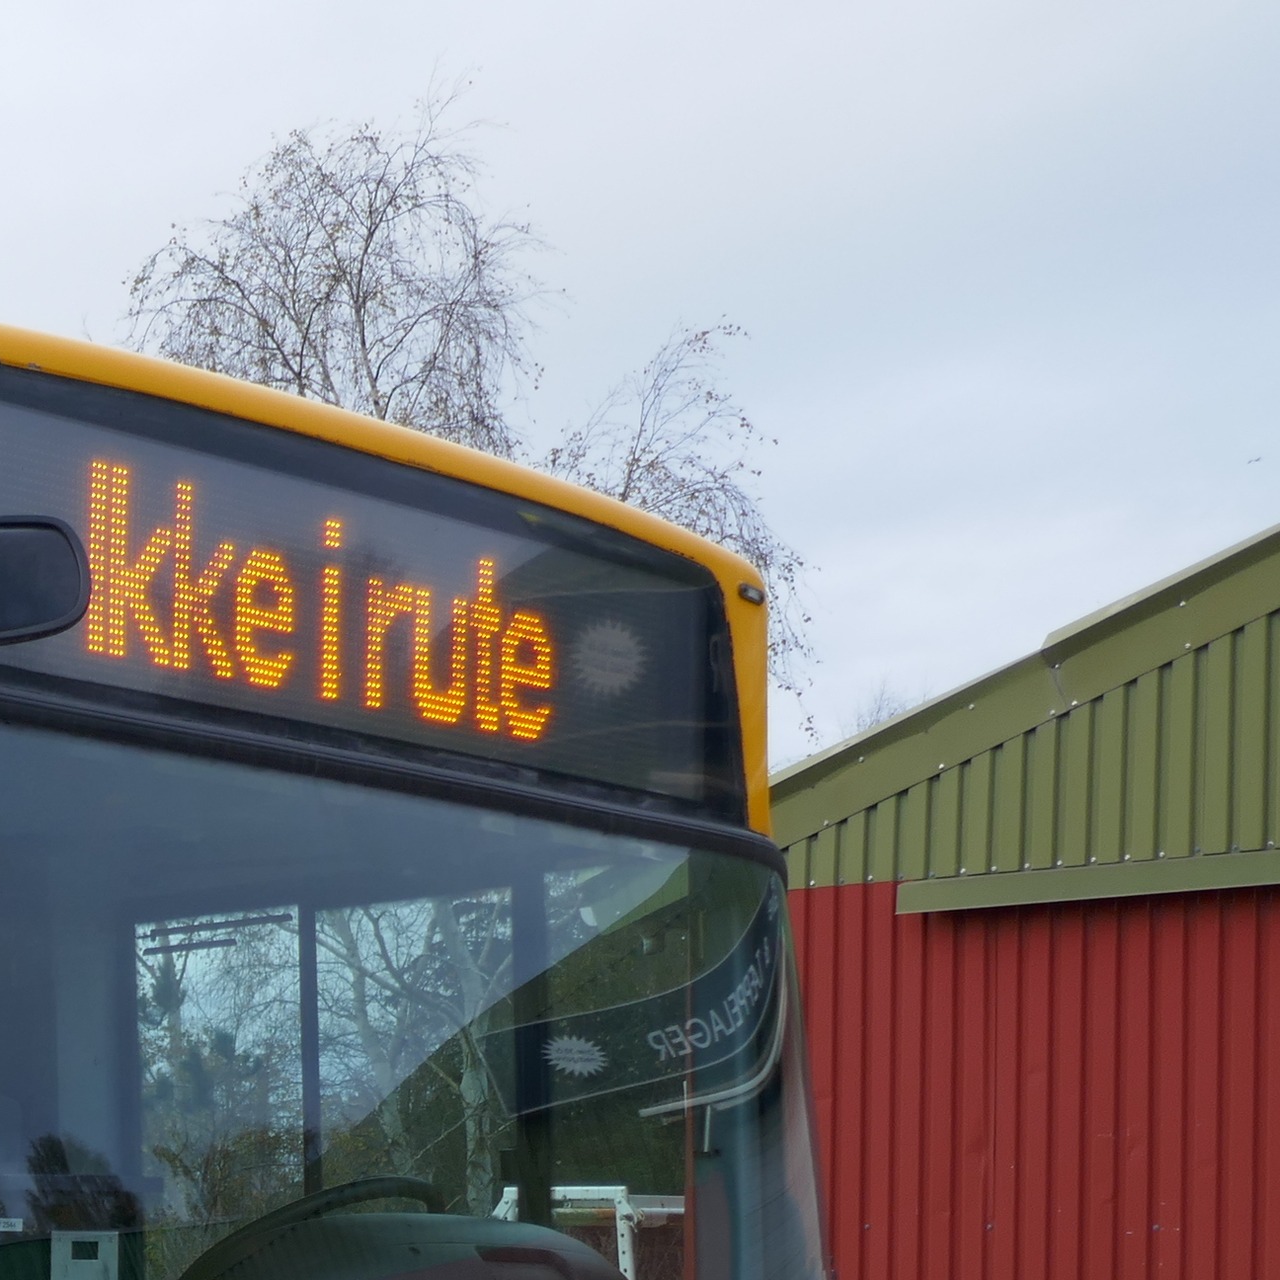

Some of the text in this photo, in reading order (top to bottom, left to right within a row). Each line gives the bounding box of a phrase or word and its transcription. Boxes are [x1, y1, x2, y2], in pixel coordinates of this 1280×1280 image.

[86, 460, 555, 741] Ikke i rute
